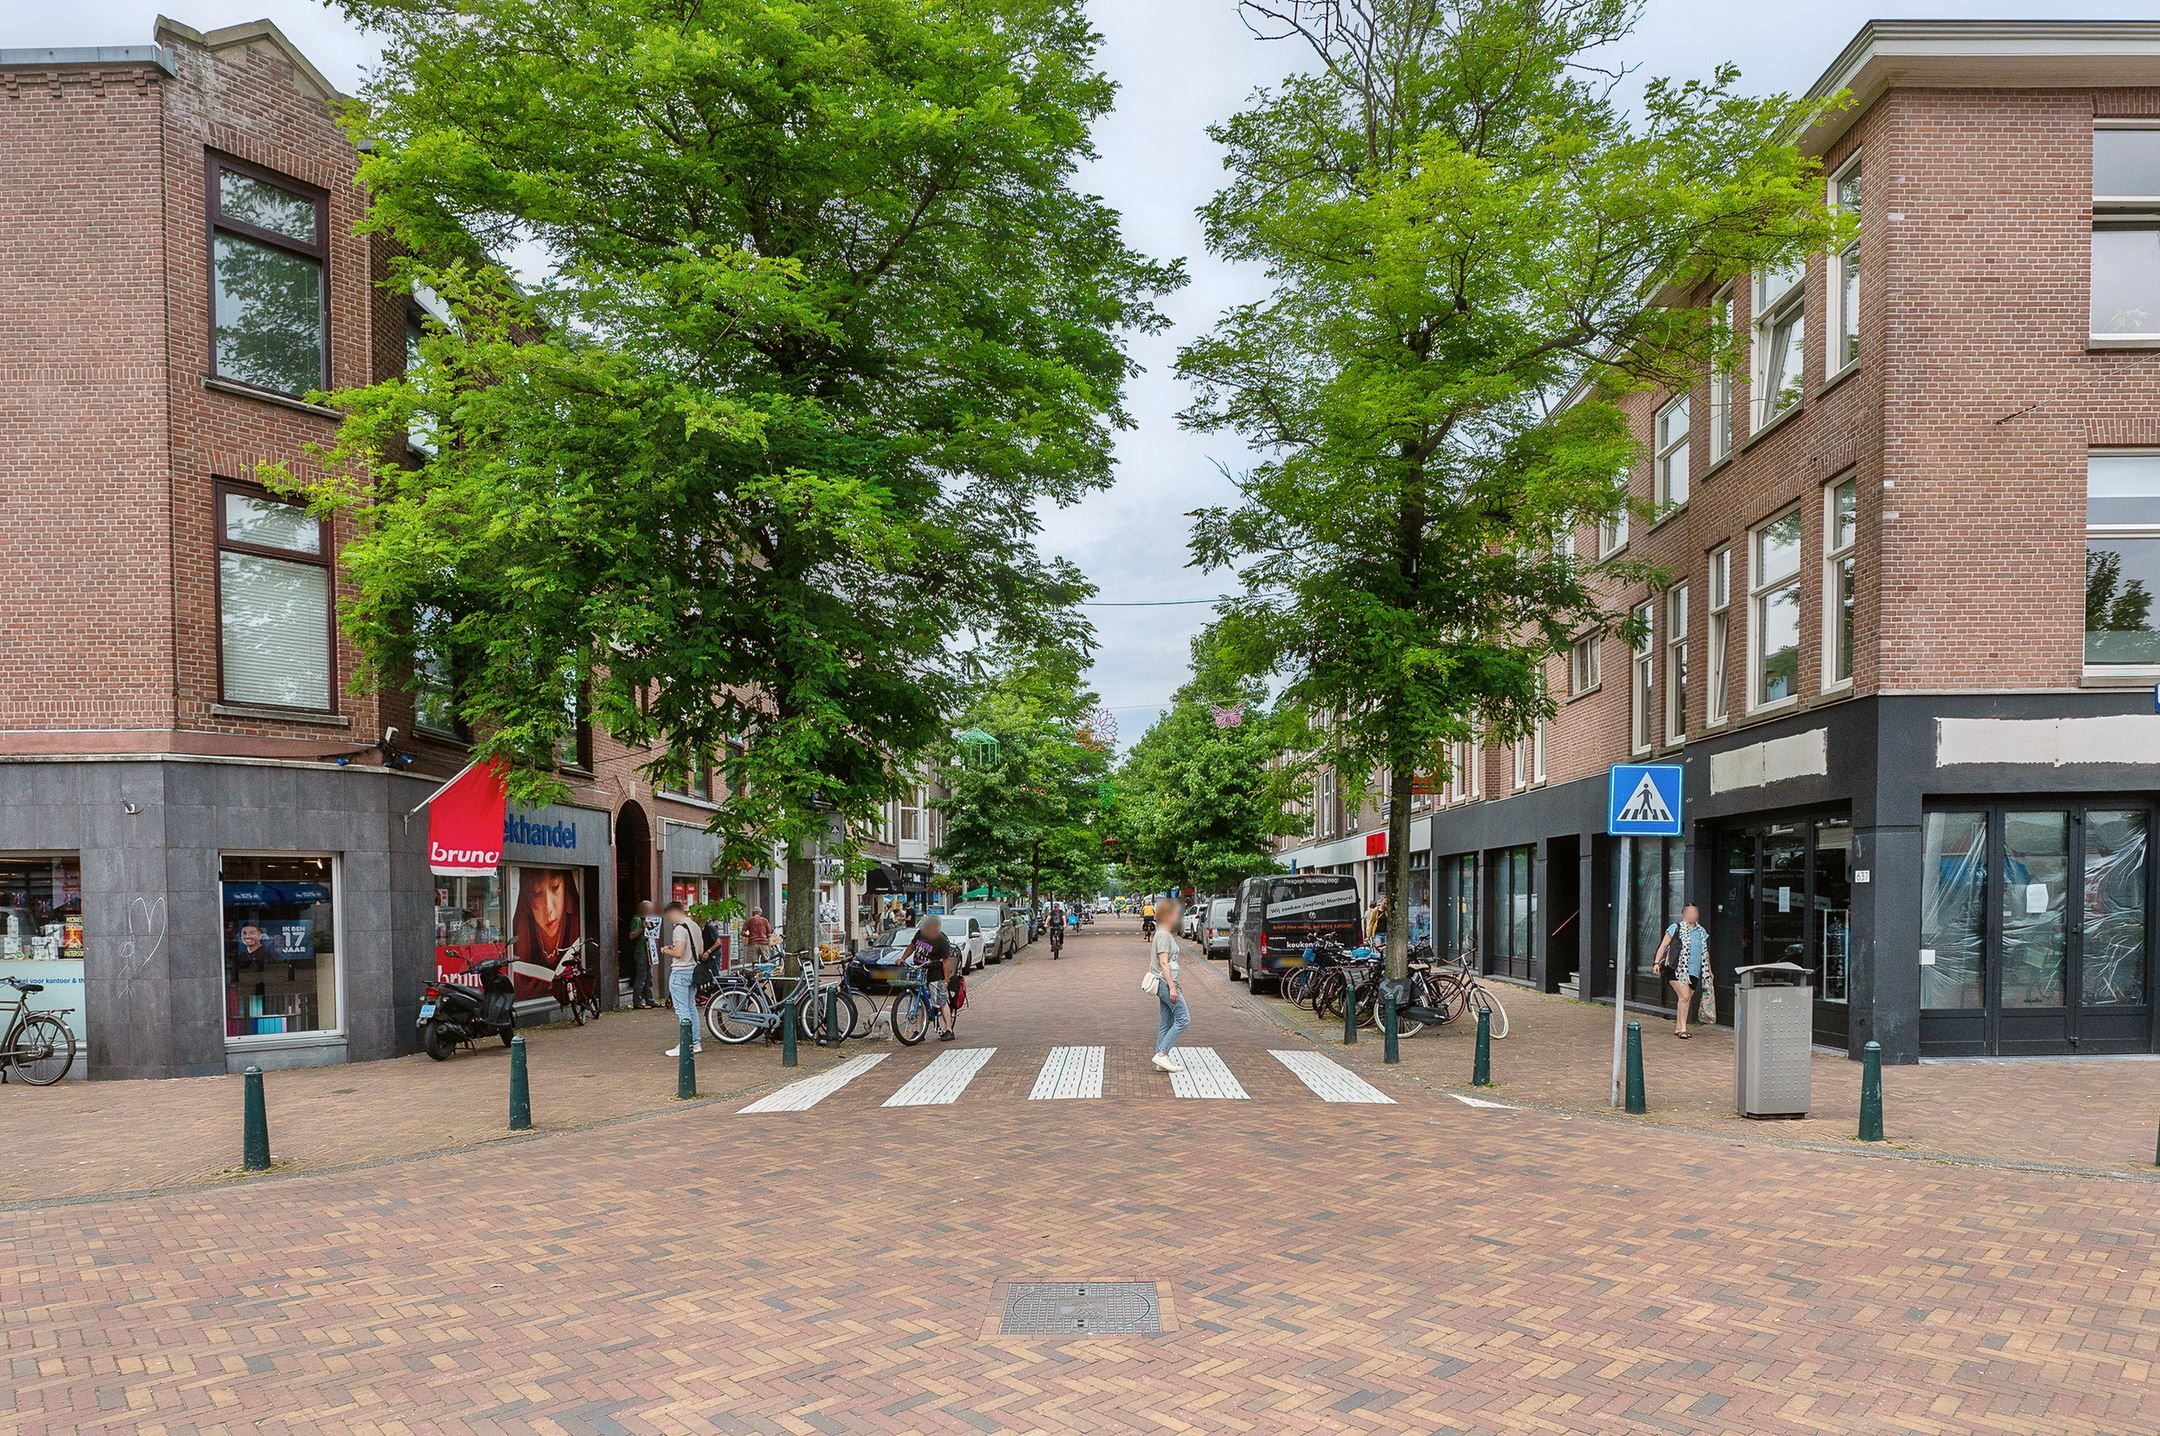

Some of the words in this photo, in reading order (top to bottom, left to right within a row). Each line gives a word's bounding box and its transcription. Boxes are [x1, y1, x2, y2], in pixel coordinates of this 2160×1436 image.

[1857, 872, 1869, 881] 637
[1326, 895, 1353, 904] Monteurs!
[282, 932, 305, 947] 17
[437, 964, 484, 989] brun
